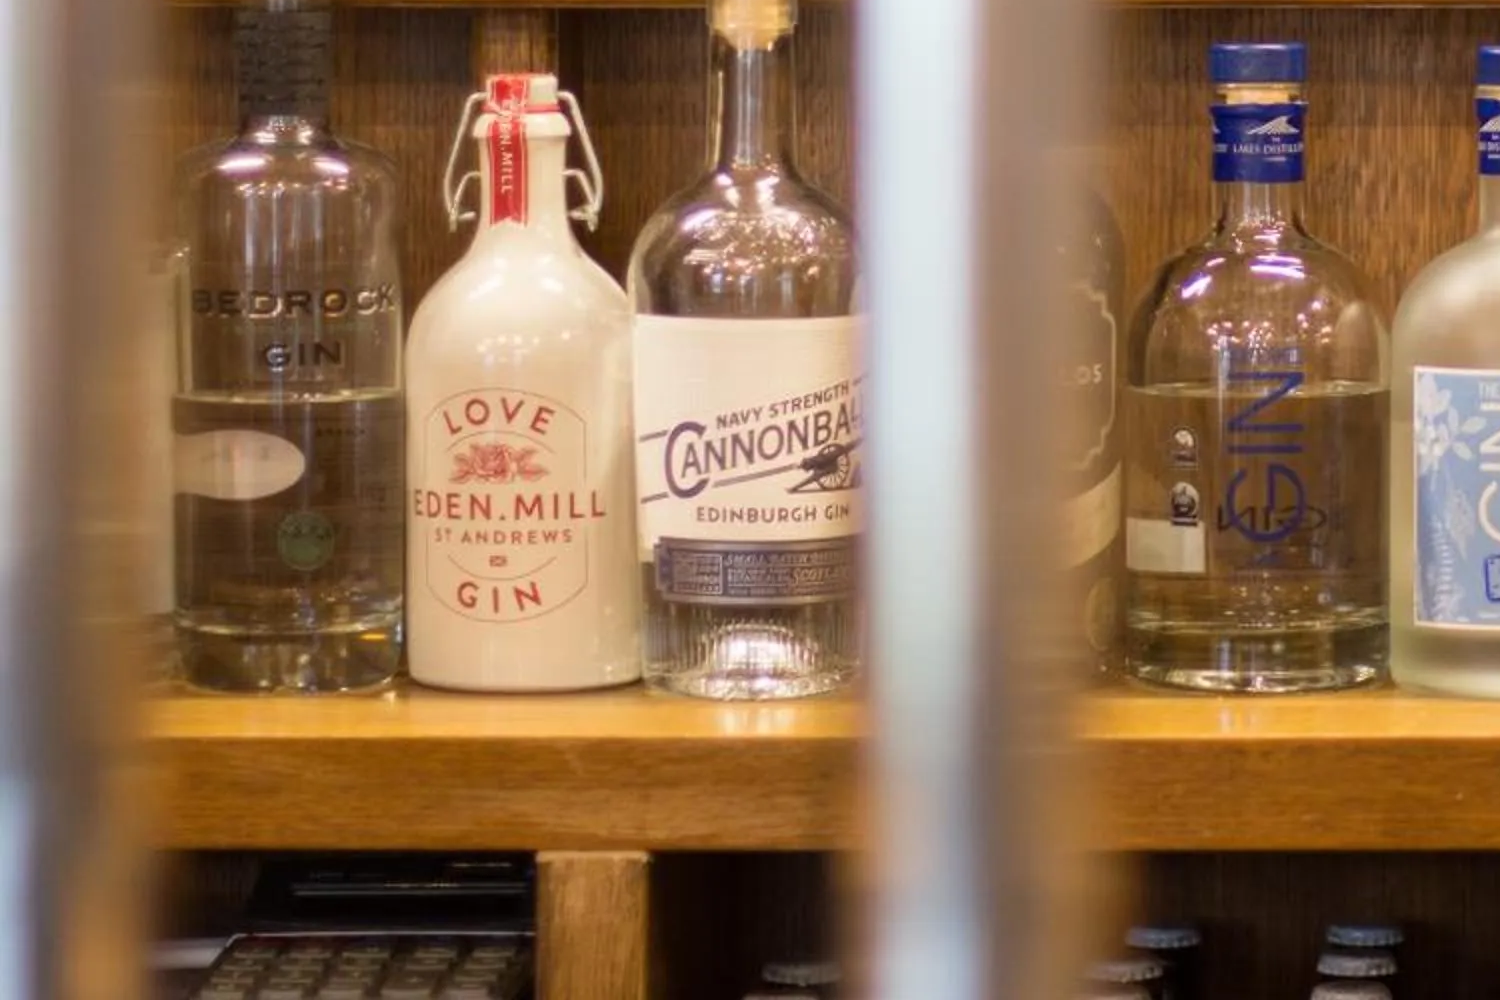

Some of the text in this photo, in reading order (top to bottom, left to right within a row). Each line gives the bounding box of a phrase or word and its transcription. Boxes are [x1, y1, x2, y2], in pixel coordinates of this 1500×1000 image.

[191, 286, 397, 318] BEDROCK
[264, 341, 342, 371] GIN
[443, 397, 555, 435] LOVE
[716, 380, 850, 429] NAVY STRENGTH
[1227, 372, 1307, 543] GIN
[696, 503, 850, 524] EDINBURGH GIN
[460, 529, 573, 545] ANDREWS
[456, 581, 542, 614] GIN
